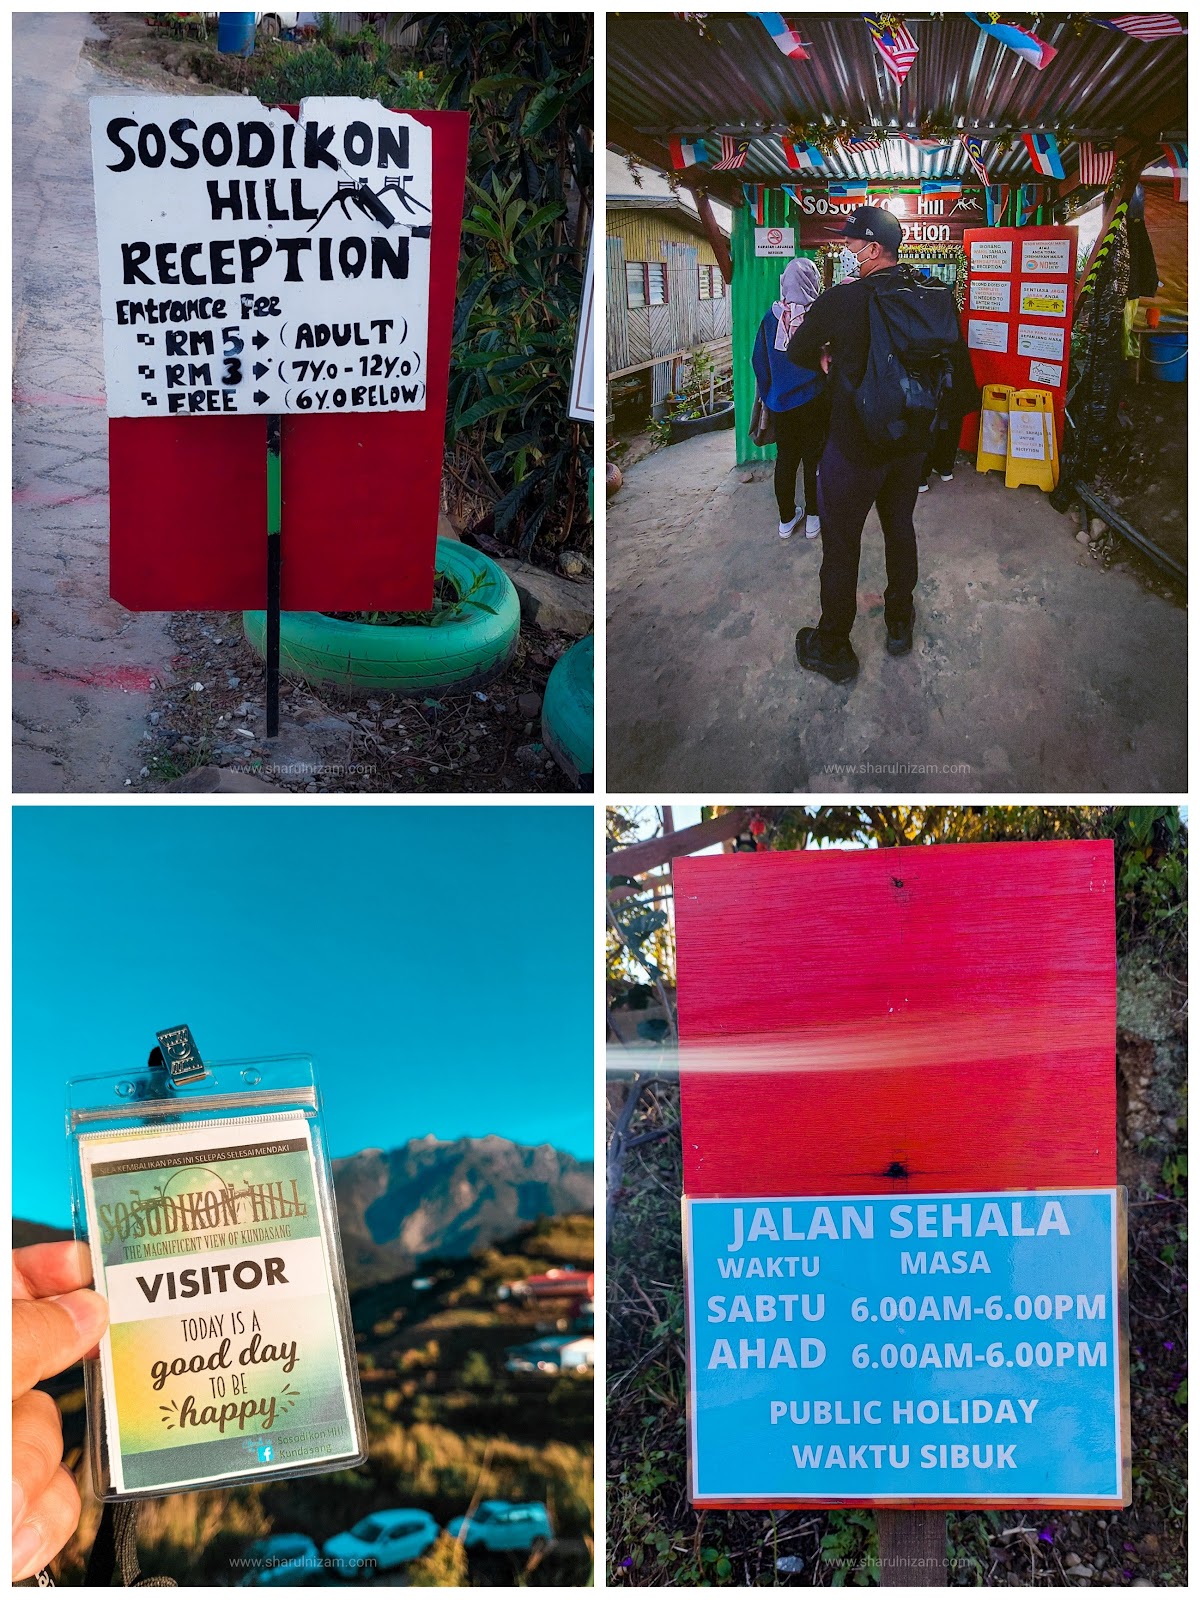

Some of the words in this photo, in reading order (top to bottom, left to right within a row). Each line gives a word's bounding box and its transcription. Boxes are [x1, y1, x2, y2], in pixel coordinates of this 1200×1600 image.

[106, 117, 410, 172] SOSODIKON
[207, 178, 319, 221] HILL
[918, 196, 943, 215] Hill
[121, 236, 410, 286] RECEPTION
[116, 297, 228, 325] Entrance
[240, 293, 282, 320] Fee
[165, 330, 214, 356] RM
[221, 326, 244, 356] 5
[165, 363, 212, 388] RM
[221, 358, 243, 386] 3
[168, 389, 238, 412] FREE
[118, 1159, 167, 1172] KEMBALIKAN
[167, 1156, 182, 1166] PAS
[183, 1155, 193, 1164] INI
[194, 1153, 226, 1163] SELEPAS
[226, 1148, 254, 1160] SELESAI
[255, 1144, 290, 1155] MENDAKI
[100, 1188, 240, 1245] SOSODIKON
[249, 1179, 308, 1222] HILL
[727, 1204, 874, 1252] JALAN
[889, 1201, 1070, 1239] SEHALA
[123, 1245, 142, 1260] THE
[143, 1237, 202, 1257] MAGNIFICENT
[204, 1234, 226, 1248] VIEW
[228, 1233, 239, 1245] OF
[241, 1225, 291, 1244] KUNDASANG
[136, 1256, 290, 1303] VISITOR
[717, 1256, 821, 1280] WAKTU
[900, 1250, 991, 1275] MASA
[707, 1294, 825, 1324] SABTU
[851, 1294, 1106, 1323] 6.00AM-6.00PM
[181, 1314, 224, 1342] TODAY
[231, 1311, 245, 1334] IS
[252, 1309, 261, 1332] A
[151, 1338, 232, 1391] good
[239, 1333, 300, 1373] day
[707, 1338, 826, 1370] AHAD
[851, 1341, 1108, 1370] 6.00AM-6.00PM
[209, 1376, 225, 1399] TO
[232, 1373, 248, 1396] BE
[179, 1395, 279, 1433] happy
[770, 1400, 882, 1426] PUBLIC
[893, 1399, 1038, 1424] HOLIDAY
[280, 1444, 332, 1458] Kundasang
[792, 1444, 910, 1469] WAKTU
[920, 1444, 1017, 1469] SIBUK
